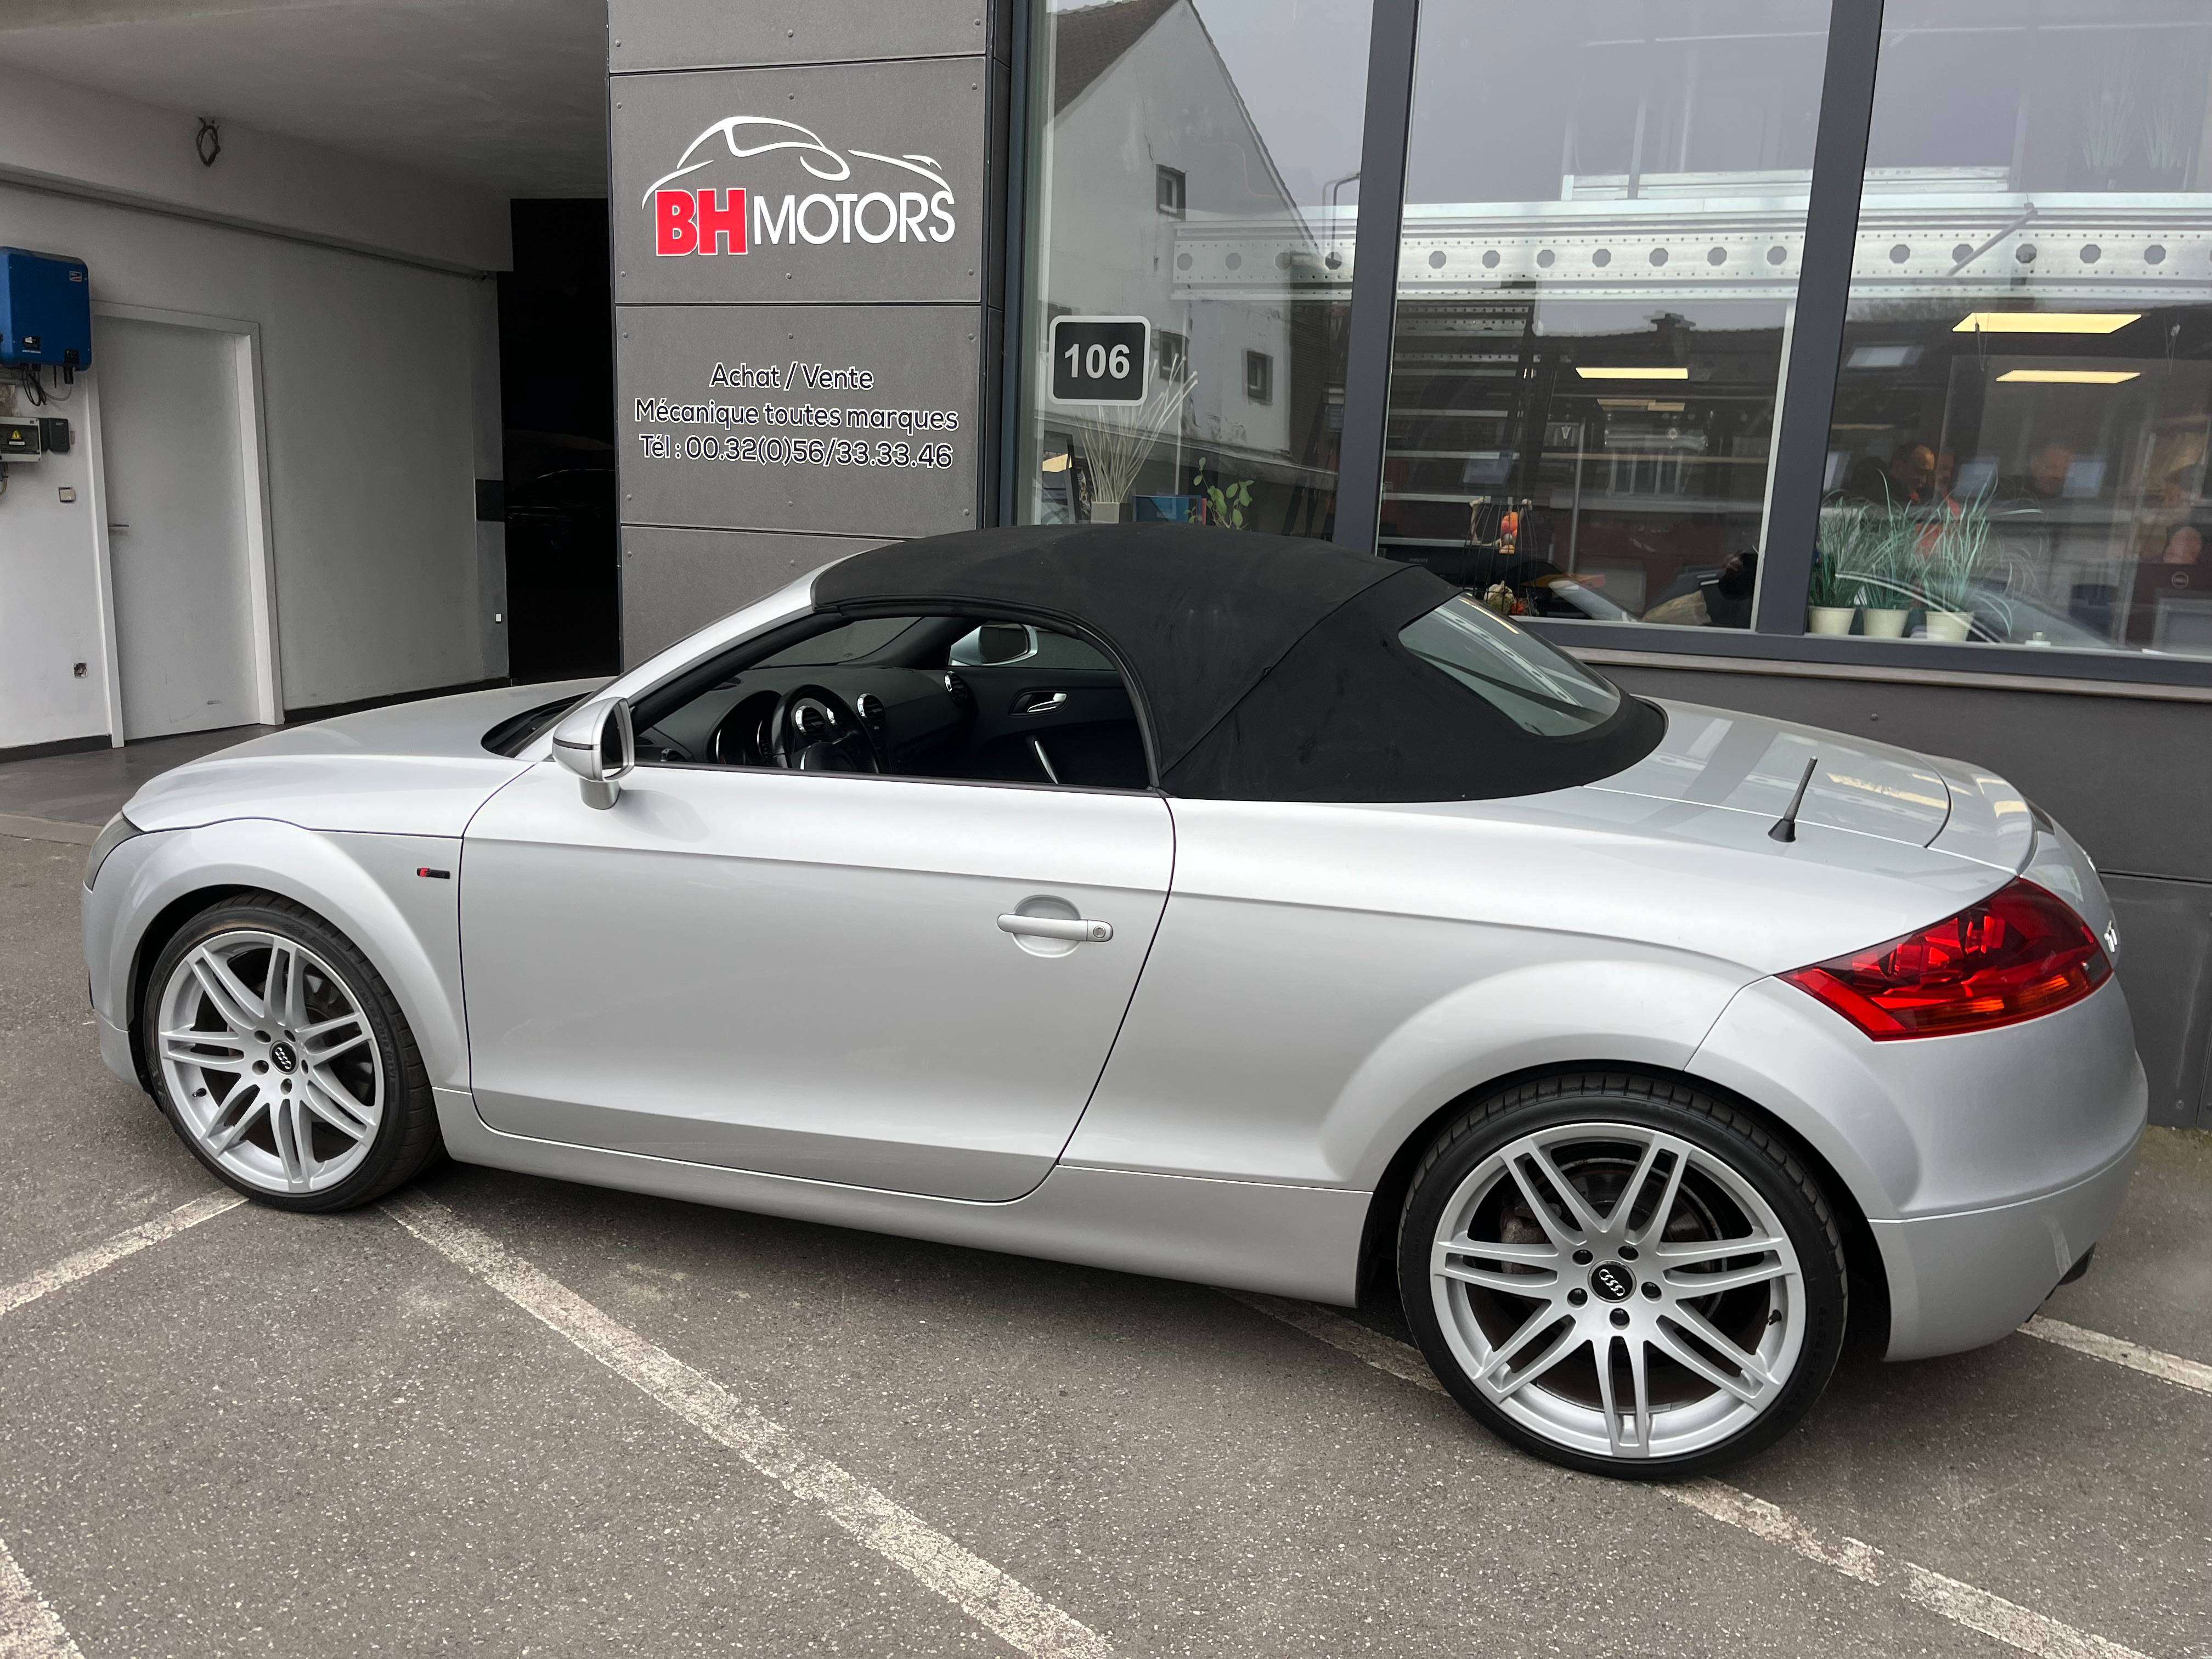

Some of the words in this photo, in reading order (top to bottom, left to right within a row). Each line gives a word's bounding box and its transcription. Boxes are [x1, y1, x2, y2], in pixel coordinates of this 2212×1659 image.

[655, 188, 748, 256] BH
[754, 192, 955, 244] MOTORS
[709, 362, 781, 388] Achat
[800, 363, 874, 390] Vente
[1065, 343, 1130, 379] 106
[635, 398, 759, 431] Mécanique
[763, 403, 842, 427] toutes
[847, 409, 958, 436] marques
[685, 435, 953, 469] 00.32(0)56/33.33.46
